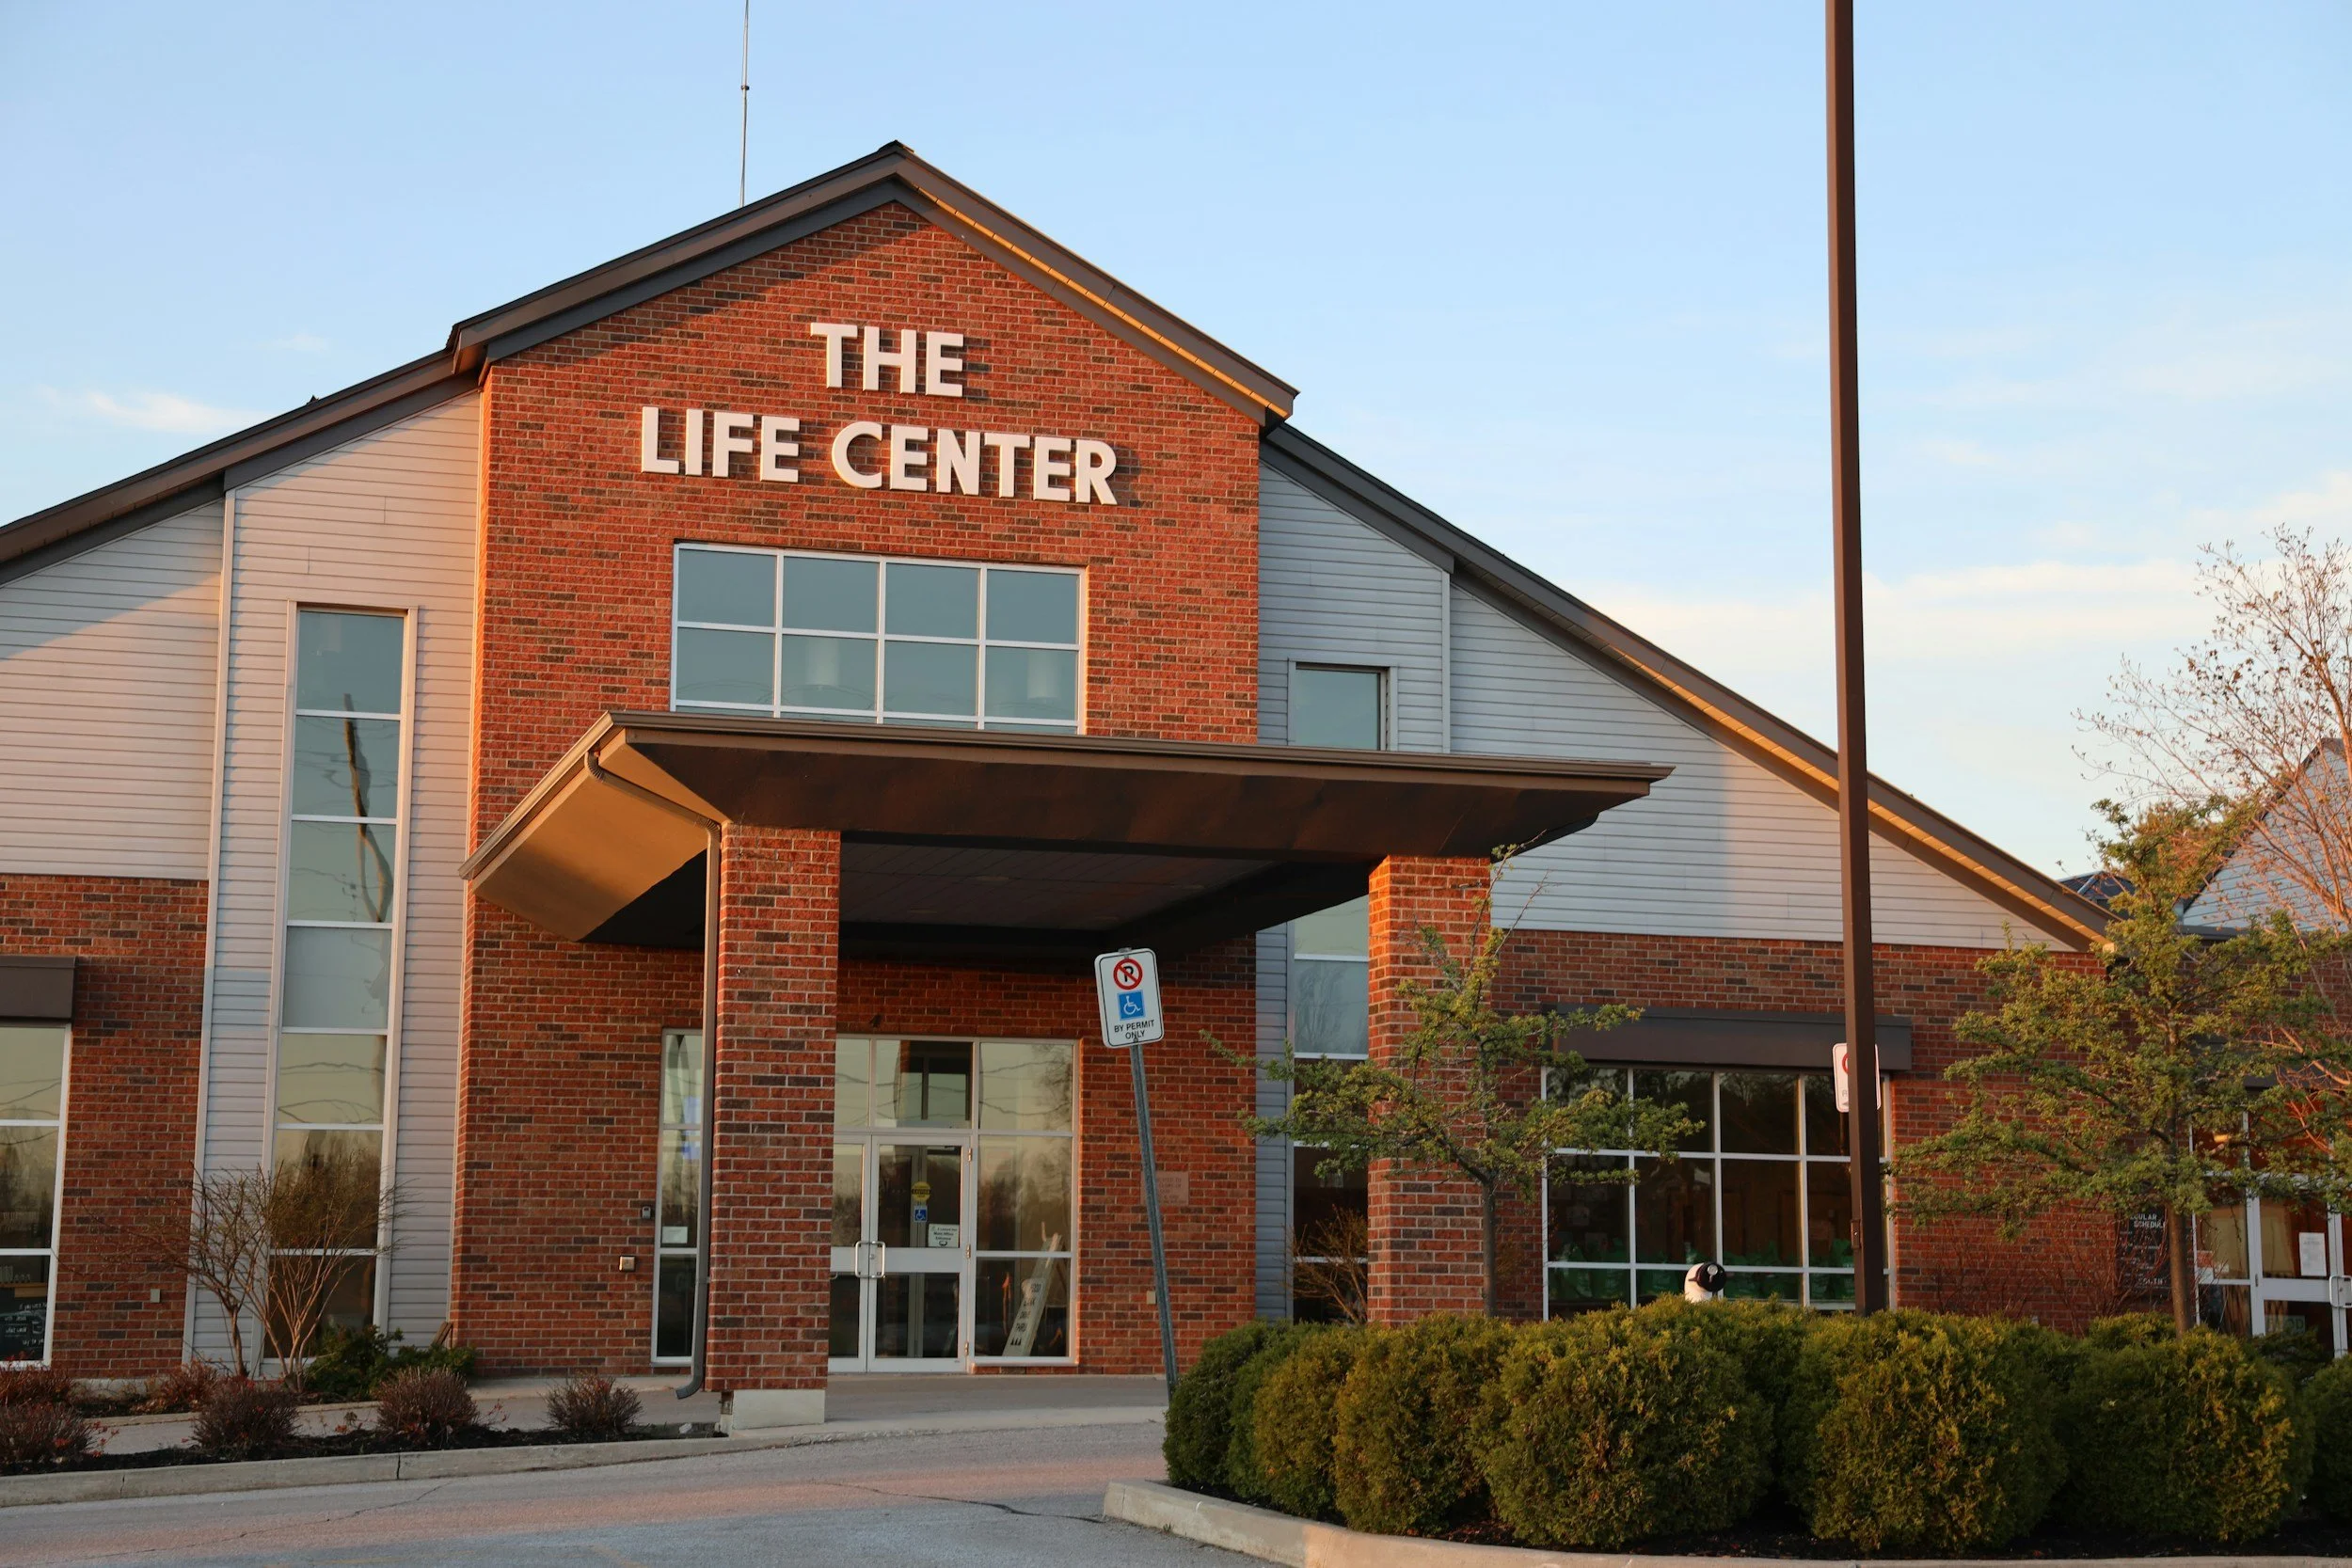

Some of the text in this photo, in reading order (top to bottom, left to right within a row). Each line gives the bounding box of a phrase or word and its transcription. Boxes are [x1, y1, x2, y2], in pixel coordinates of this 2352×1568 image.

[811, 323, 963, 398] THE
[641, 406, 1118, 506] LIFE CENTER
[1114, 1019, 1155, 1033] BY PERMIT
[1125, 1029, 1145, 1039] ONLY
